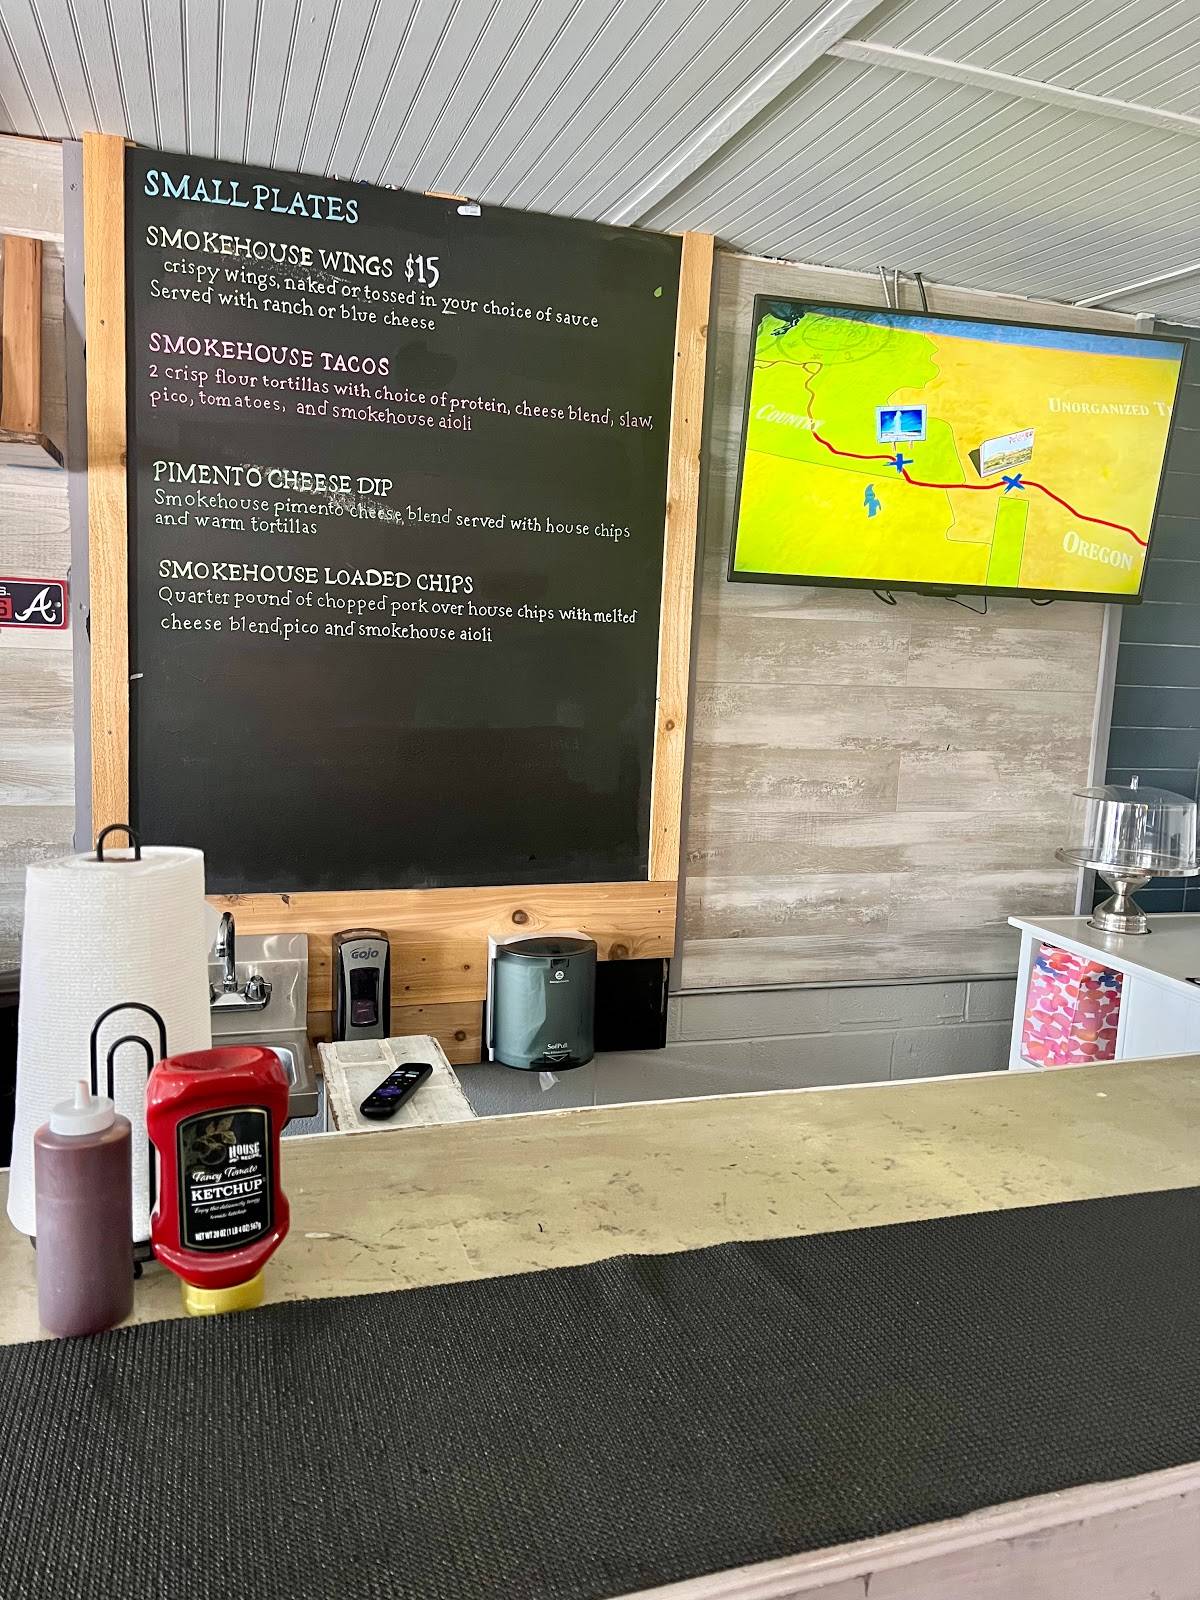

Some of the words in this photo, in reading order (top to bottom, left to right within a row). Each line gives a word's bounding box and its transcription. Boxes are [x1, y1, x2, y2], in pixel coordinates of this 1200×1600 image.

[144, 170, 249, 208] SMALL
[252, 184, 359, 224] PLATES
[146, 225, 314, 266] SMOKEHOUSE
[318, 248, 393, 278] WINGS
[404, 253, 440, 288] $15
[150, 279, 214, 304] Served
[218, 289, 258, 310] with
[263, 297, 314, 317] ranch
[318, 305, 336, 320] or
[341, 304, 377, 323] blue
[383, 311, 436, 331] cheese
[164, 258, 221, 284] crispy
[224, 268, 280, 292] wings,
[284, 276, 340, 296] naked
[341, 284, 361, 299] or
[363, 285, 417, 305] tossed
[420, 291, 437, 307] in
[441, 297, 478, 314] your
[483, 301, 532, 319] choice
[536, 307, 553, 322] of
[555, 311, 599, 328] sauce
[149, 332, 314, 368] SMOKEHOUSE
[320, 352, 390, 376] TACOS
[149, 364, 159, 378] 2
[165, 365, 209, 387] crisp
[215, 368, 258, 388] flour
[262, 375, 329, 394] tortillas
[333, 381, 371, 398] with
[374, 385, 425, 404] choice
[430, 392, 448, 407] of
[450, 396, 511, 415] protein,
[515, 401, 565, 420] cheese
[568, 405, 614, 427] blend,
[619, 412, 653, 430] slaw,
[150, 388, 194, 407] pico,
[198, 391, 286, 413] tomatoes,
[296, 400, 328, 416] and
[332, 406, 434, 427] smokehouse
[438, 414, 472, 431] aioli
[152, 461, 263, 488] PIMENTO
[267, 469, 352, 494] CHEESE
[357, 477, 394, 497] DIP
[154, 489, 269, 511] Smokehouse
[274, 498, 344, 517] pimento
[406, 505, 452, 524] blend
[456, 514, 507, 529] served
[510, 517, 541, 532] with
[545, 517, 590, 536] house
[594, 523, 631, 542] chips
[155, 511, 191, 526] and
[194, 514, 245, 531] warm
[250, 516, 318, 534] tortillas
[1062, 530, 1134, 571] OREGON
[158, 559, 319, 584] SMOKEHOUSE
[324, 567, 412, 589] LOADED
[416, 573, 474, 594] CHIPS
[158, 586, 230, 606] Quarter
[234, 590, 293, 608] pound
[295, 591, 313, 607] of
[317, 593, 388, 615] chopped
[390, 598, 429, 617] pork
[431, 602, 464, 616] over
[468, 600, 513, 617] house
[517, 604, 554, 623] chips
[558, 606, 592, 622] with
[593, 608, 638, 624] melted
[160, 614, 222, 632] cheese
[324, 620, 356, 637] and
[358, 622, 455, 640] smokehouse
[459, 627, 493, 642] aioli
[229, 1141, 260, 1159] HOUSE
[191, 1179, 263, 1201] KETCHUP
[192, 1171, 222, 1183] Fancy
[224, 1165, 258, 1178] Tomato
[194, 1232, 205, 1241] NET
